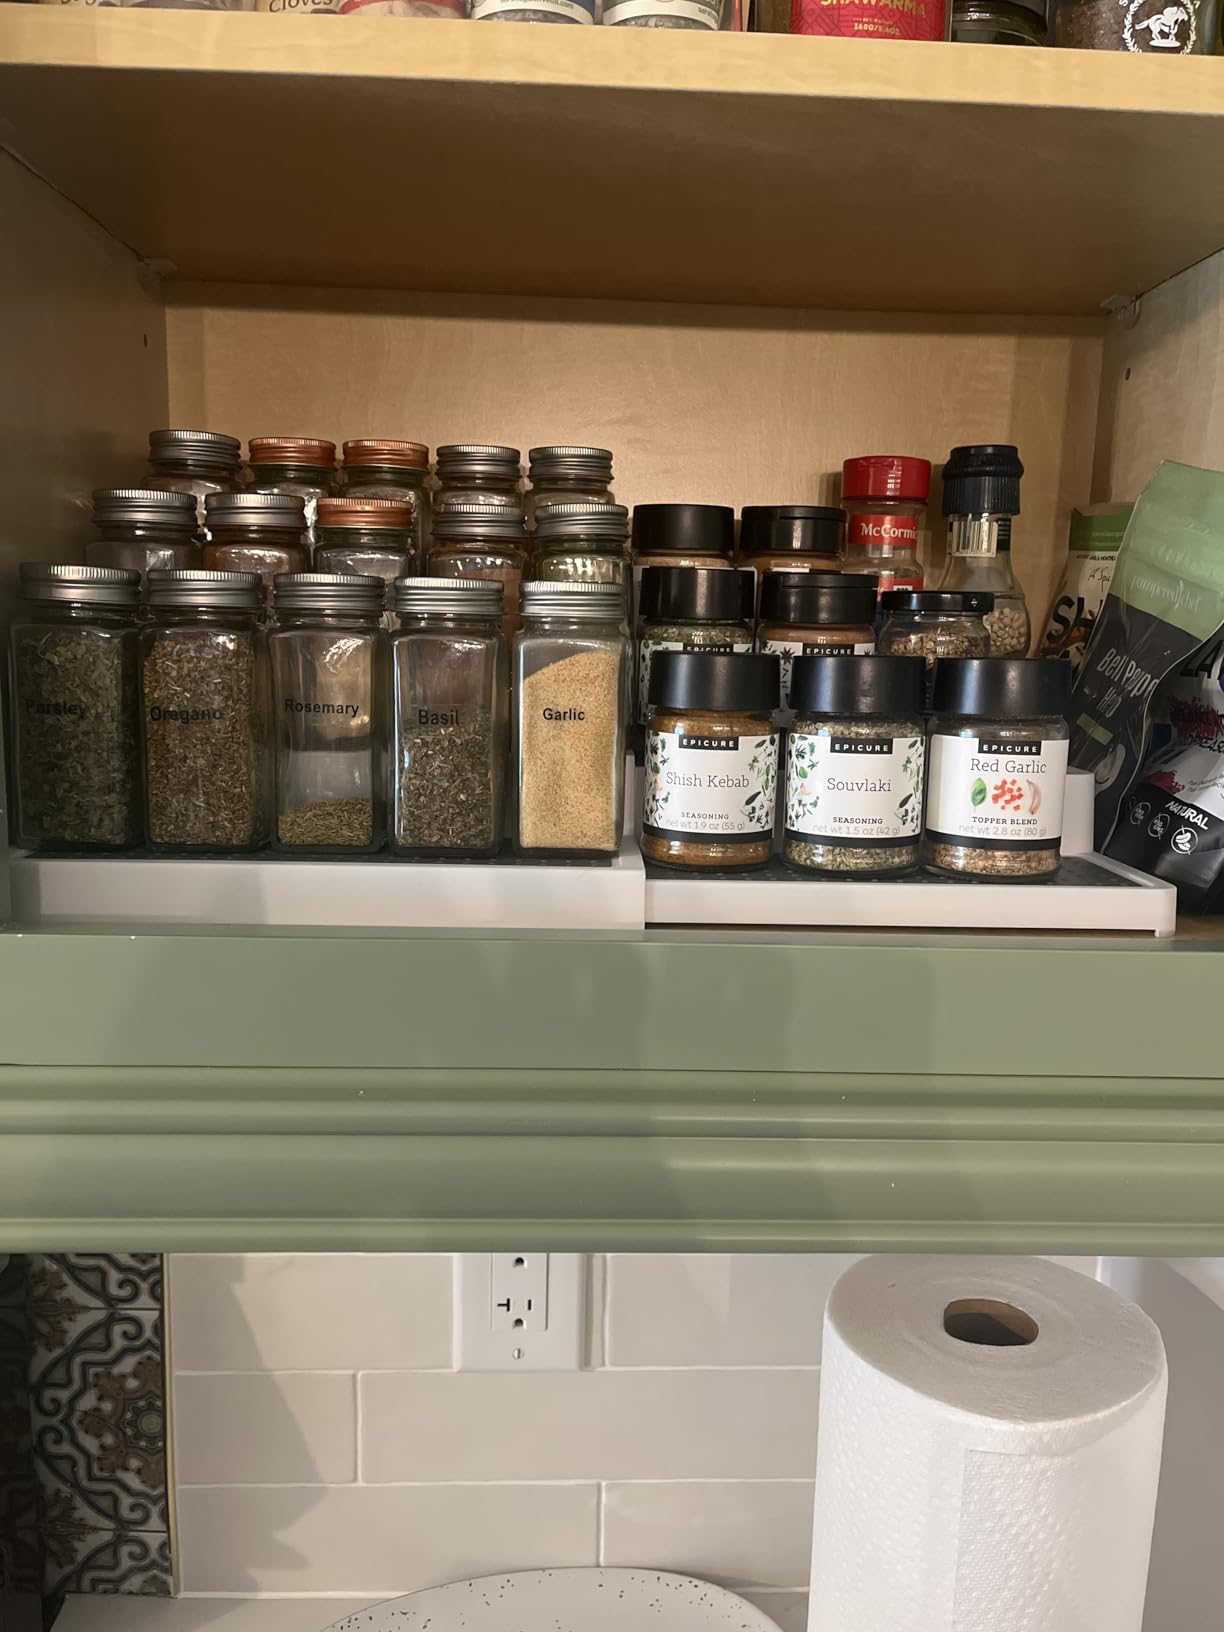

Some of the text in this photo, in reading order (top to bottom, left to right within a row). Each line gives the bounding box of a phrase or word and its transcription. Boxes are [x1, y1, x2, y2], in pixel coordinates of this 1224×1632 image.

[860, 522, 917, 540] McCormi
[806, 647, 851, 655] EPICURE
[1097, 647, 1160, 698] Bell Pepp
[25, 698, 87, 718] Parsley
[284, 699, 359, 717] Rosemary
[543, 708, 585, 721] Garlic
[150, 706, 224, 724] Oregano
[418, 709, 459, 725] Basil
[682, 739, 735, 748] EPICURE
[835, 744, 889, 752] EPICURE
[983, 744, 1037, 753] EPICURE
[970, 758, 1047, 774] Red Garlic
[666, 772, 750, 788] Shish Kebab
[827, 777, 892, 792] Souvlaki
[681, 811, 729, 820] SEASONING
[832, 817, 883, 825] SEASONING
[972, 816, 1007, 825] TOPPER
[1165, 800, 1209, 830] NATURAL
[681, 821, 692, 829] wt
[721, 821, 736, 830] (55
[813, 824, 827, 832] net
[830, 825, 843, 834] wt
[862, 827, 874, 835] oz
[876, 826, 890, 835] (42
[959, 824, 974, 833] net
[976, 826, 990, 834] wt
[1010, 828, 1022, 836] oz
[1024, 827, 1037, 837] (80
